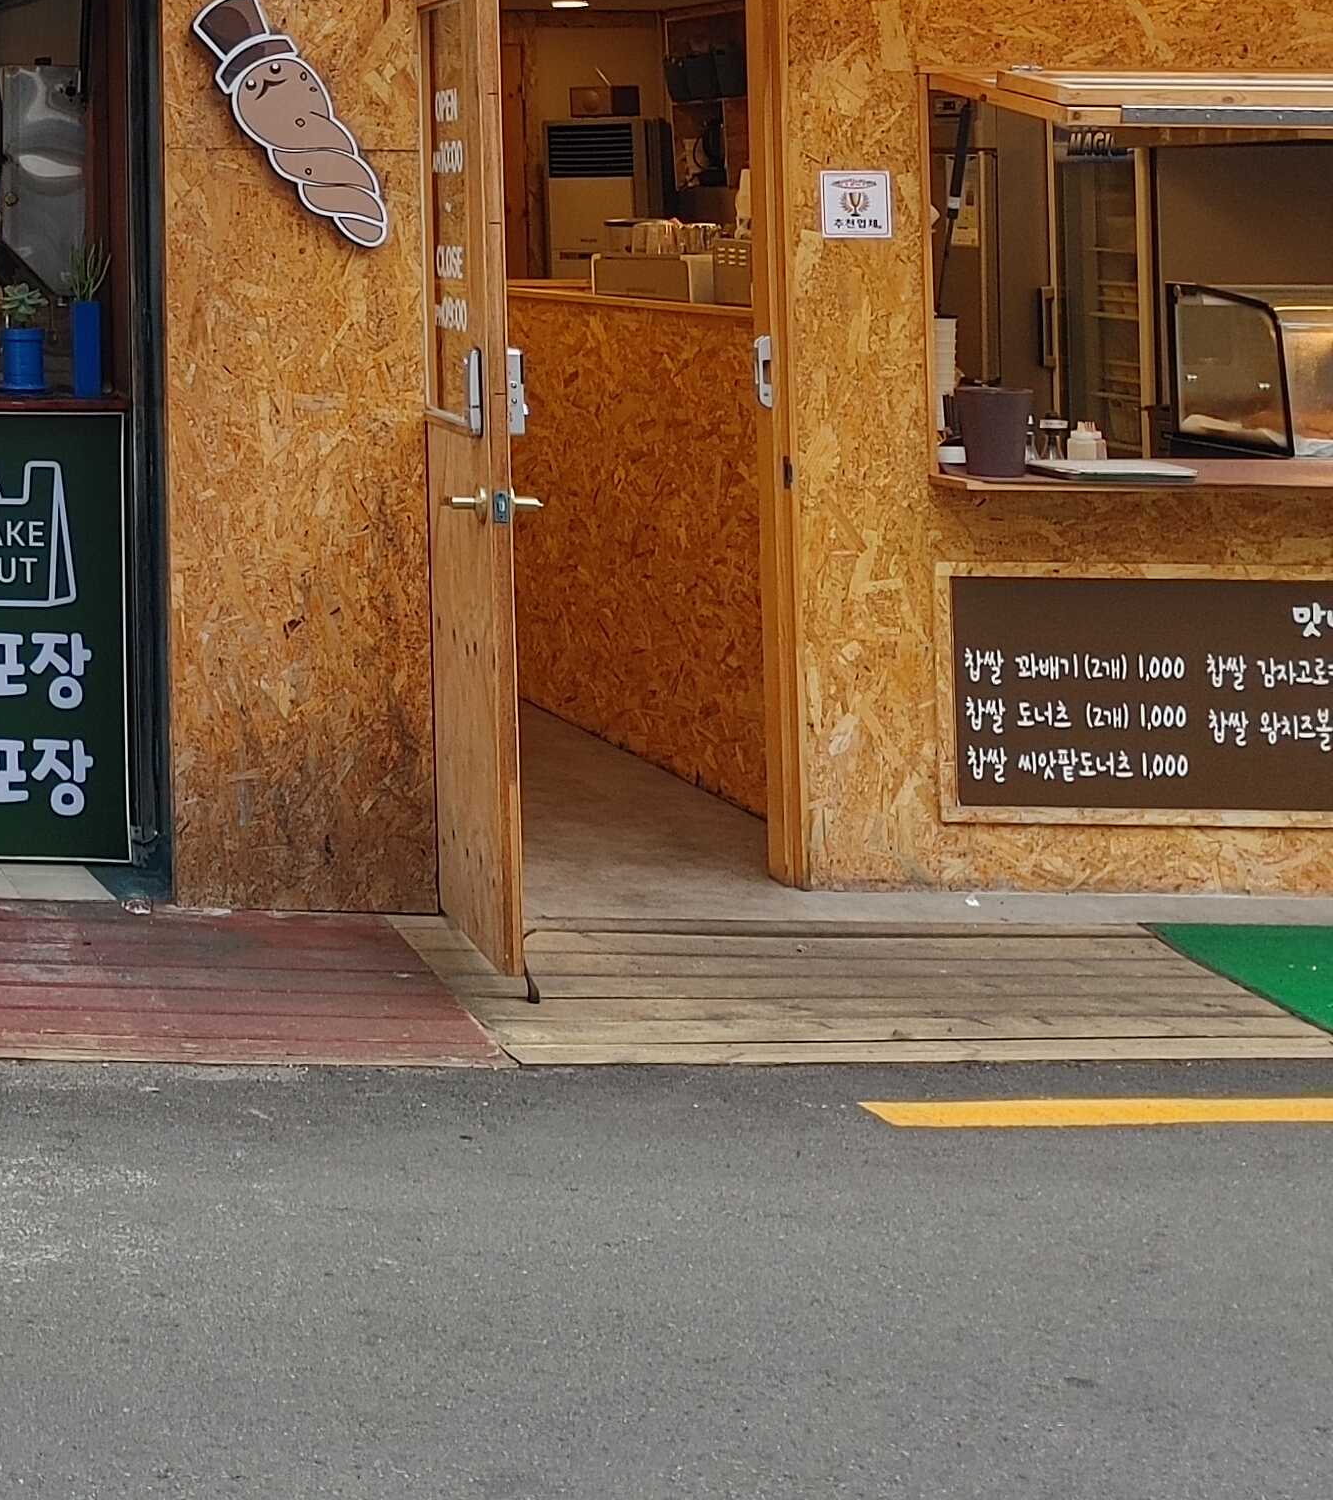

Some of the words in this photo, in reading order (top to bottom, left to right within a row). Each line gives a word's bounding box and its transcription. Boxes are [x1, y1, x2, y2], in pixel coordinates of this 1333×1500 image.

[435, 88, 458, 123] OPEN
[834, 218, 878, 229] 추천업체
[436, 245, 463, 280] CLOSE
[965, 647, 1004, 685] 찹쌀
[1015, 653, 1078, 679] 꽈배기
[1085, 653, 1128, 680] (2개)
[1138, 653, 1185, 682] 1,000
[1206, 653, 1247, 691] 찹쌀
[966, 696, 1006, 734] 찹쌀
[1017, 700, 1072, 728] 도너츠
[1086, 702, 1130, 730] (2개)
[1140, 702, 1187, 731] 1,000
[1208, 706, 1249, 747] 찹쌀
[967, 745, 1008, 783] 찹쌀
[1018, 748, 1134, 782] 씨앗팥도너츠
[1142, 752, 1189, 781] 1,000
